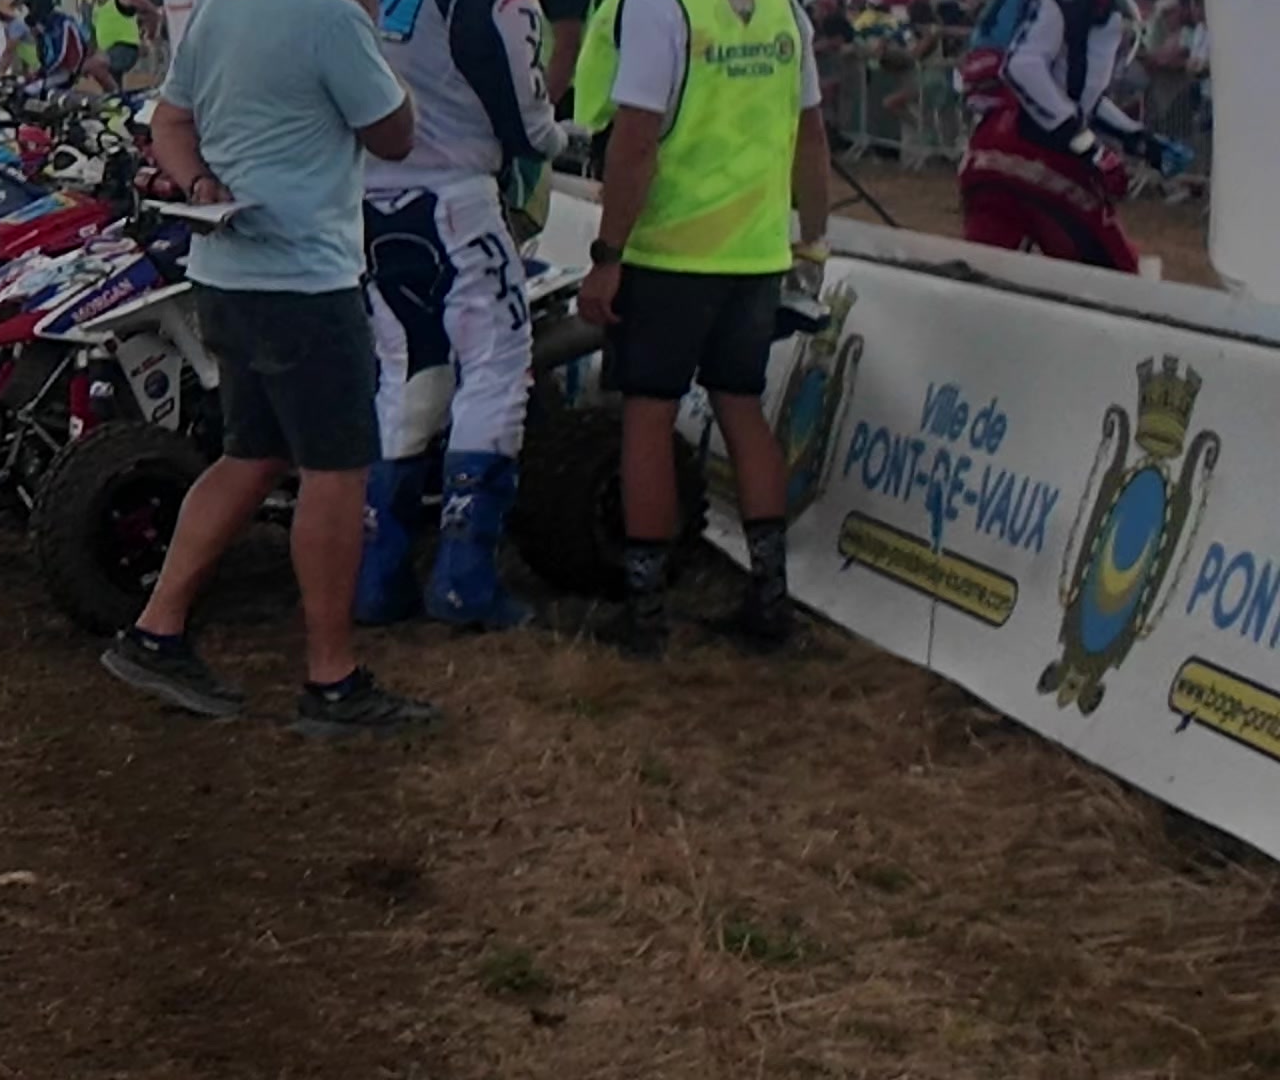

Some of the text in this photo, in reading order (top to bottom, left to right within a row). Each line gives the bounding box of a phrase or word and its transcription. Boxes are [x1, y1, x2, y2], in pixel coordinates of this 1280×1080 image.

[920, 382, 1008, 455] Ville de
[843, 420, 1061, 553] PONT-DE-VAUX
[1186, 541, 1280, 649] PON
